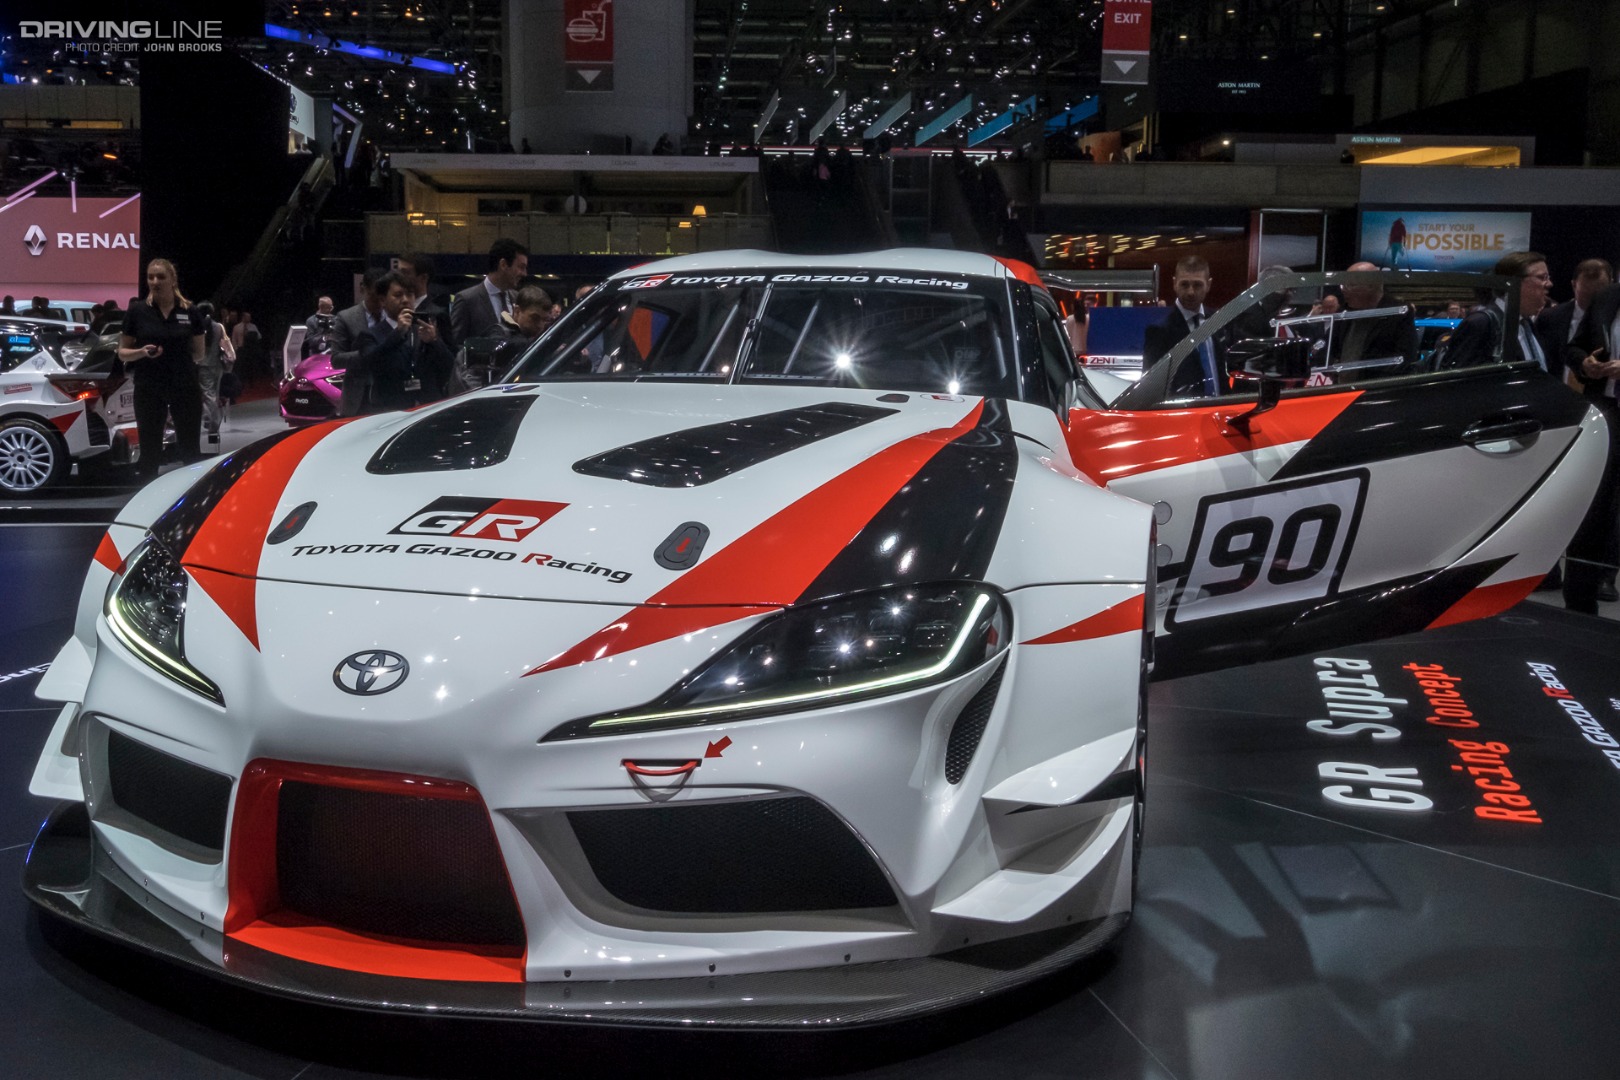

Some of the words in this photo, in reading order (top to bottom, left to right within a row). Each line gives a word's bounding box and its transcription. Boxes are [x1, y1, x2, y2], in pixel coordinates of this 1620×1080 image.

[1114, 12, 1142, 24] EXIT
[1418, 223, 1447, 232] START
[1449, 223, 1475, 232] YOUR
[671, 275, 766, 285] TOYOTA
[771, 274, 870, 283] GAZOO
[875, 275, 969, 290] Racing
[291, 543, 401, 557] TOYOTA
[405, 543, 518, 561] GAZOO
[520, 552, 633, 584] Racing
[1200, 503, 1342, 599] 90
[1306, 657, 1409, 740] Supra
[1402, 662, 1480, 728] Concept
[1526, 661, 1575, 699] Racing
[1557, 699, 1620, 748] GAZOO
[1317, 761, 1434, 811] GR
[1447, 738, 1543, 824] Racing
